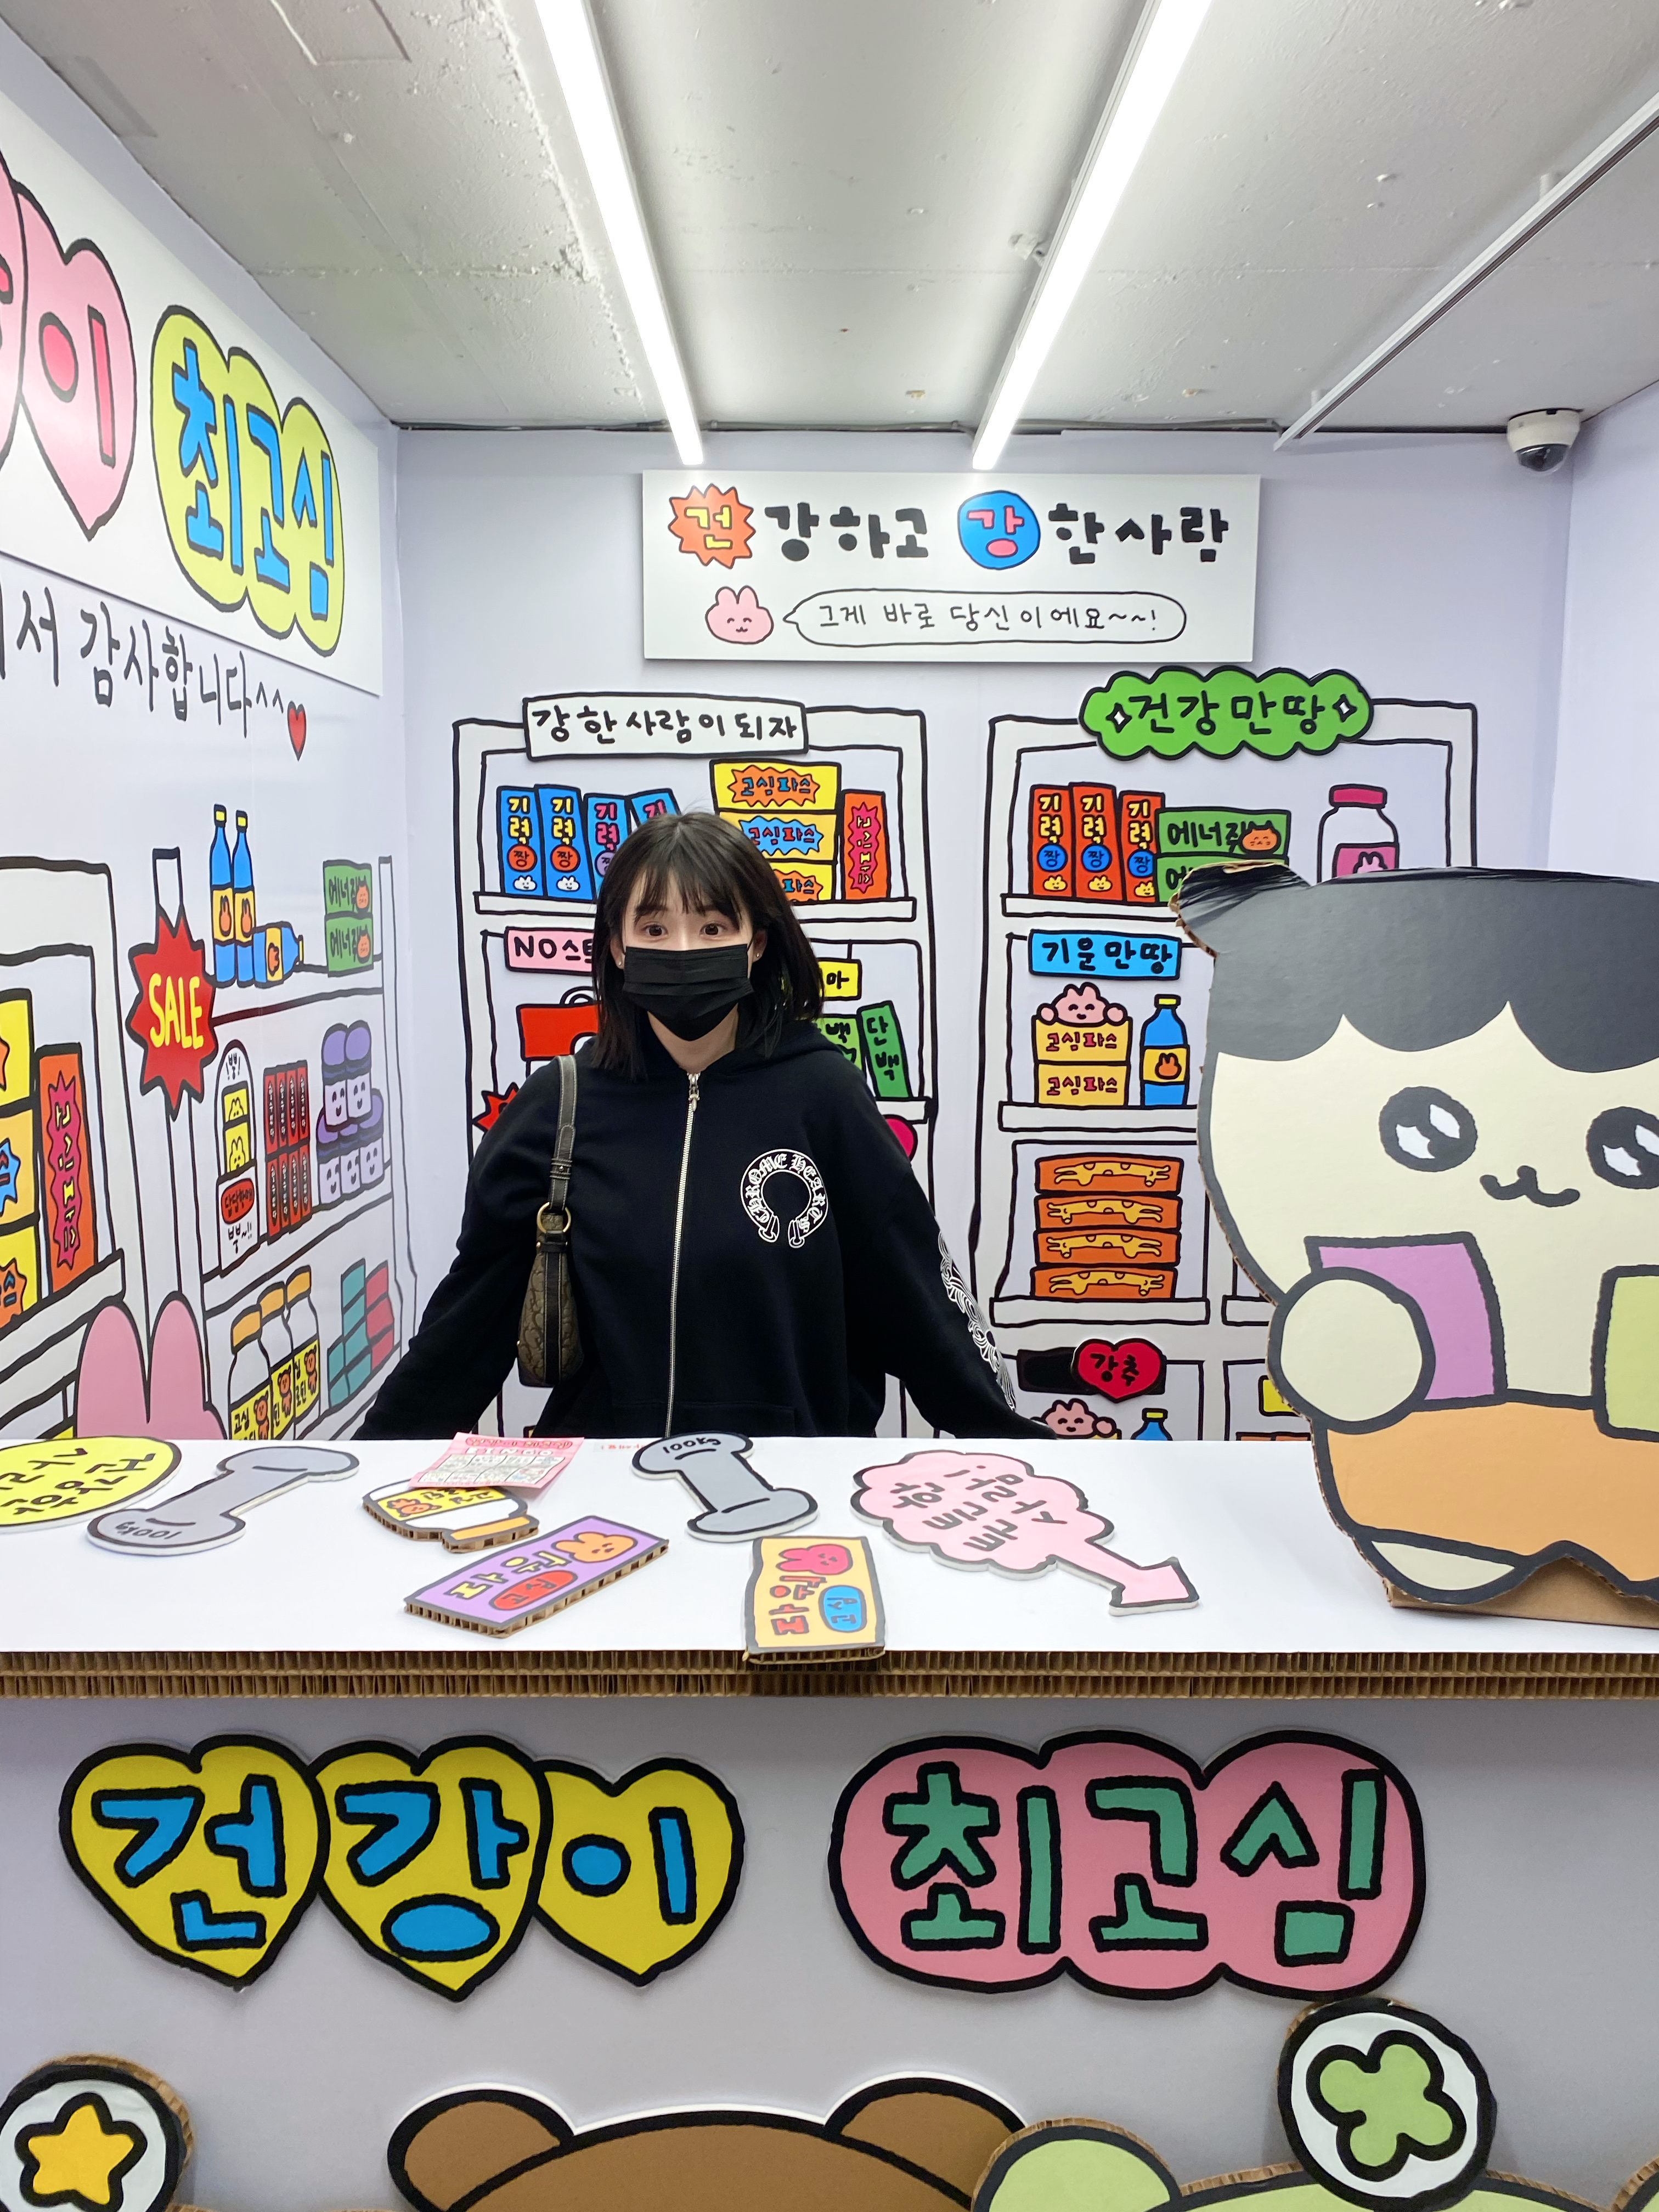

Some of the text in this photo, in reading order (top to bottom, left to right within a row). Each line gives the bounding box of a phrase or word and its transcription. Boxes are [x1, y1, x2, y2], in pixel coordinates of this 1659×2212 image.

[172, 337, 334, 622] 최고심
[685, 502, 1229, 563] 건강하고 강한 사람
[818, 603, 866, 627] 그게
[883, 603, 935, 628] 바로
[532, 706, 798, 744] 강한 사람이 되자
[741, 776, 811, 795] 고심파스
[748, 826, 815, 845] 고심파스
[149, 973, 204, 1049] SALE
[1046, 1031, 1118, 1052] 고심파스
[1046, 1076, 1118, 1096] 고심파스
[745, 1153, 826, 1233] CHROME HEARTS
[1090, 1352, 1139, 1387] 강추
[444, 1550, 573, 1600] 파워
[769, 1575, 827, 1636] 파워
[92, 1774, 696, 1961] 건강이
[882, 1761, 1386, 1967] 최고심
